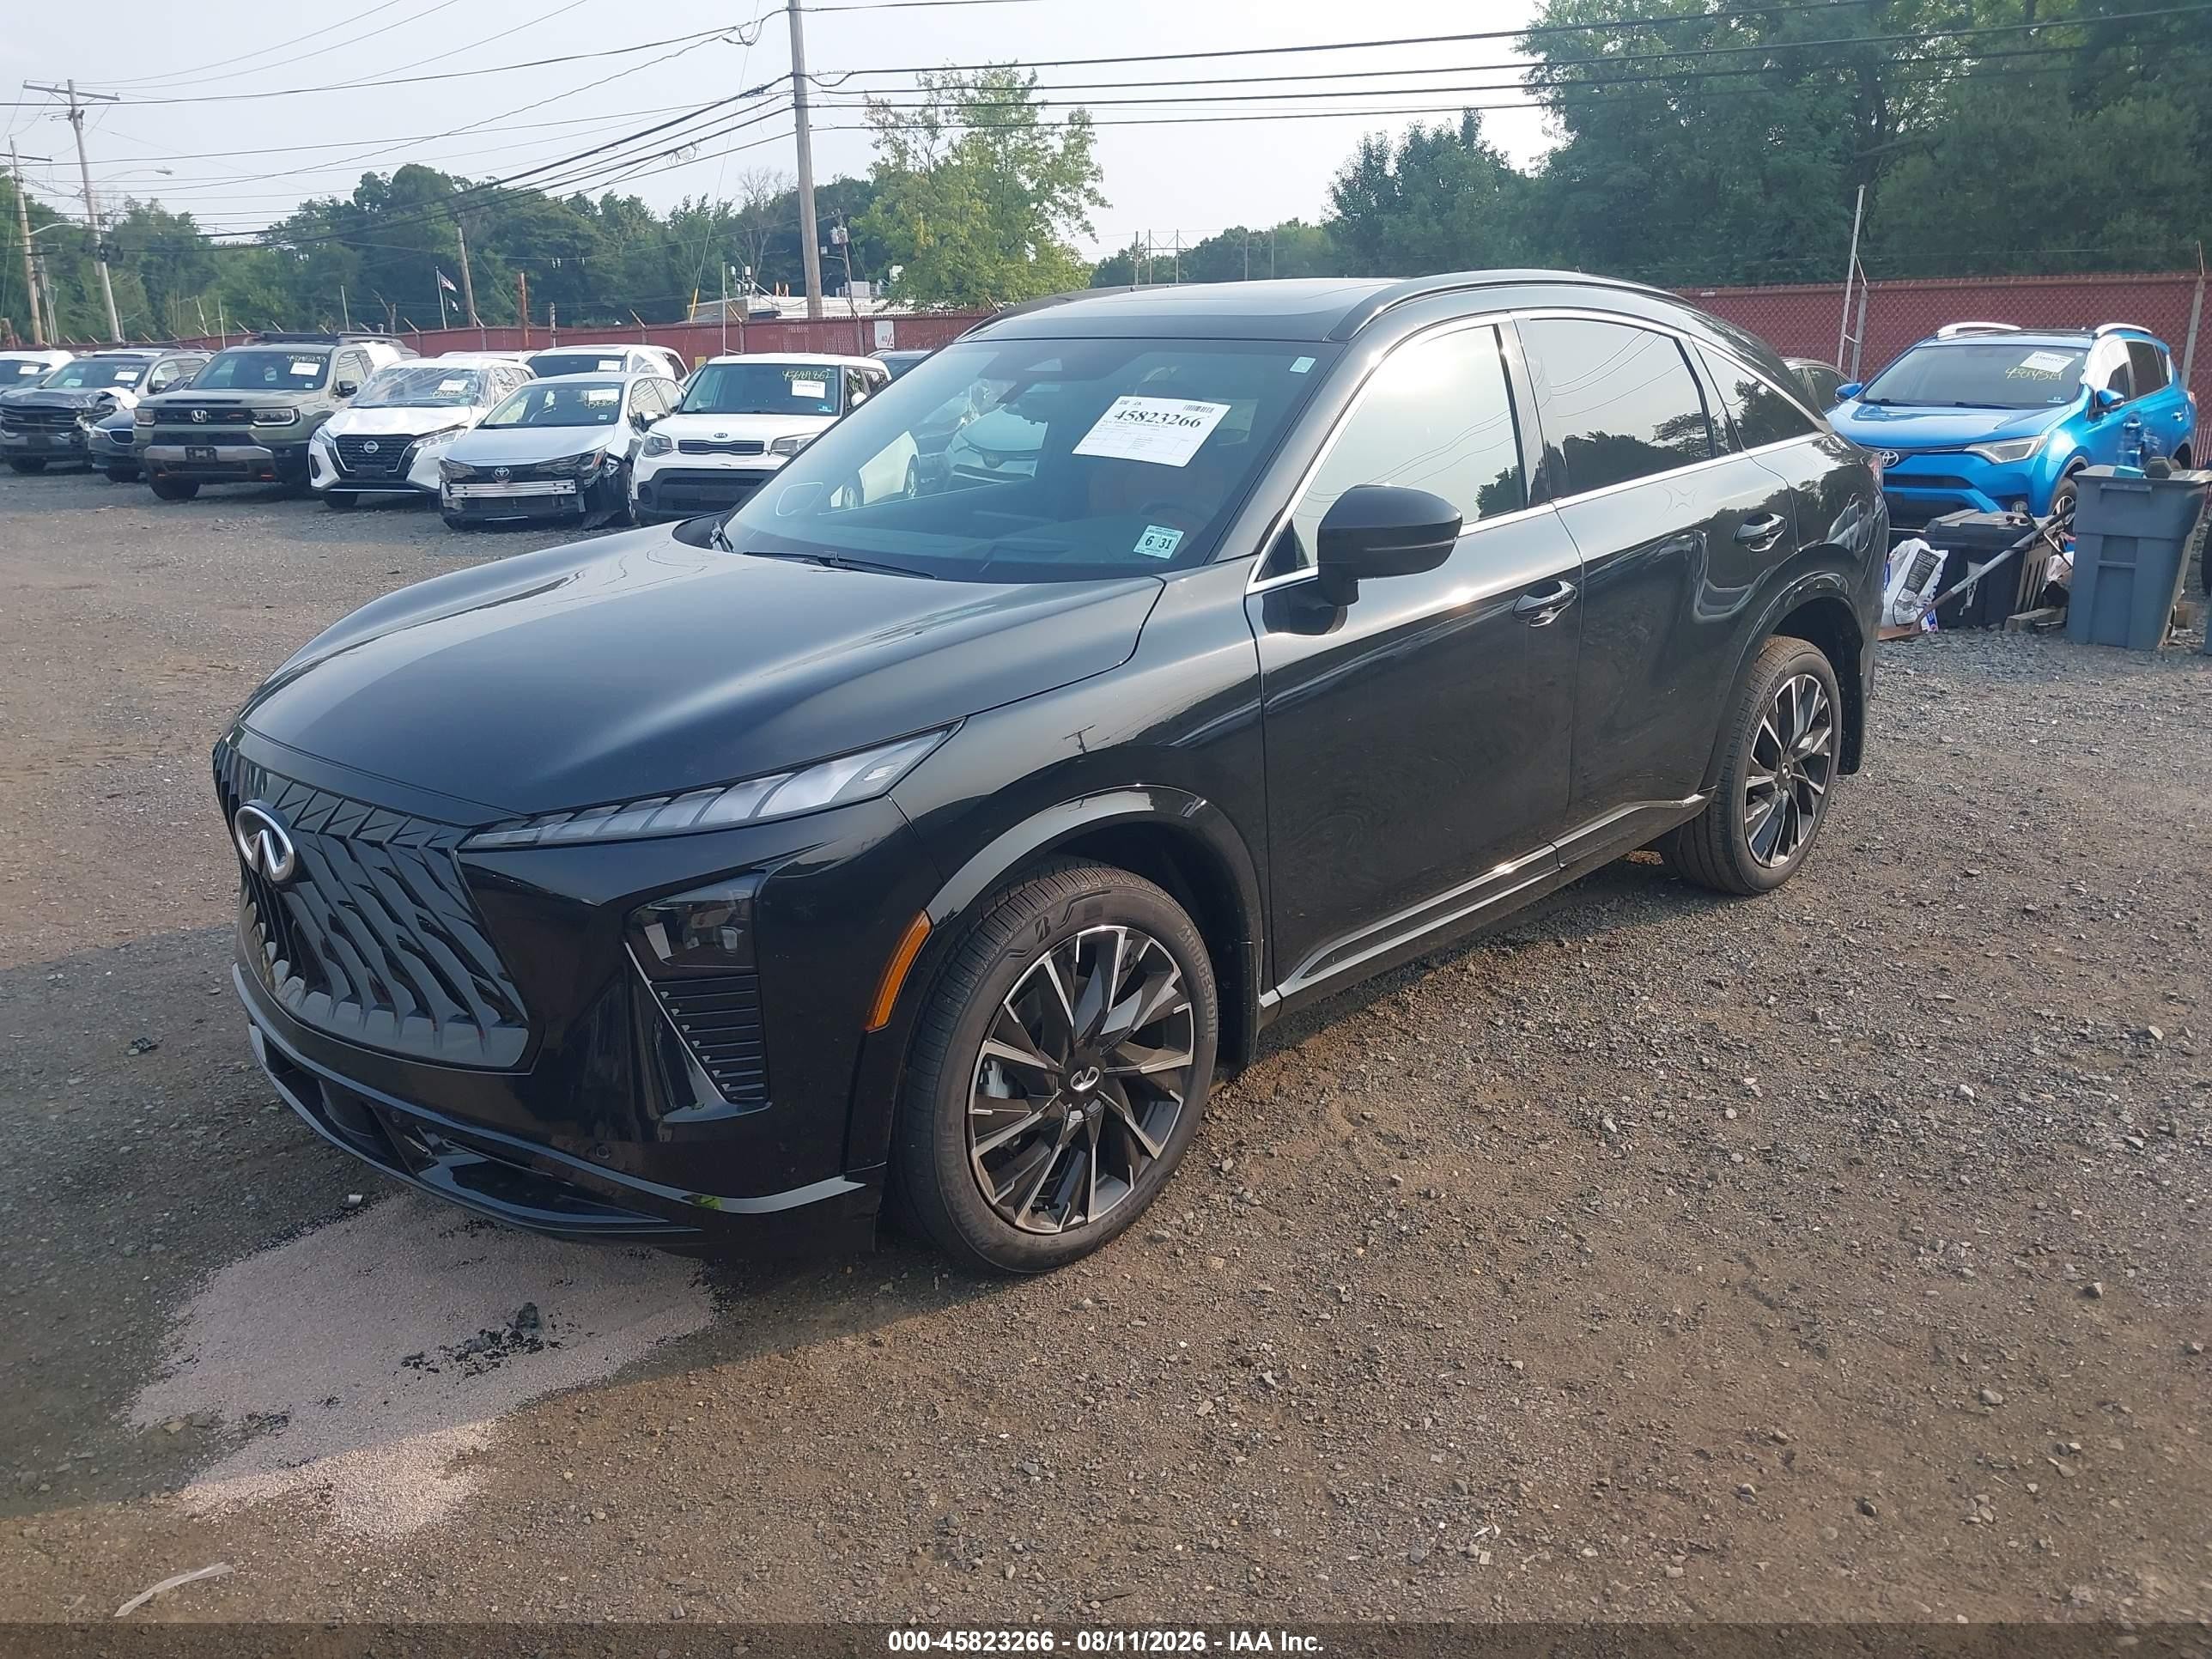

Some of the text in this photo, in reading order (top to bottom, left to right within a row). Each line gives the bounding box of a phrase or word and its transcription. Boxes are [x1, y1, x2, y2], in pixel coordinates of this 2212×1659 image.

[1114, 410, 1204, 428] 45823266
[1145, 535, 1173, 550] 6 31
[1746, 665, 1787, 745] BRIDGESTONE
[1176, 923, 1216, 1043] BRIDGESTONE
